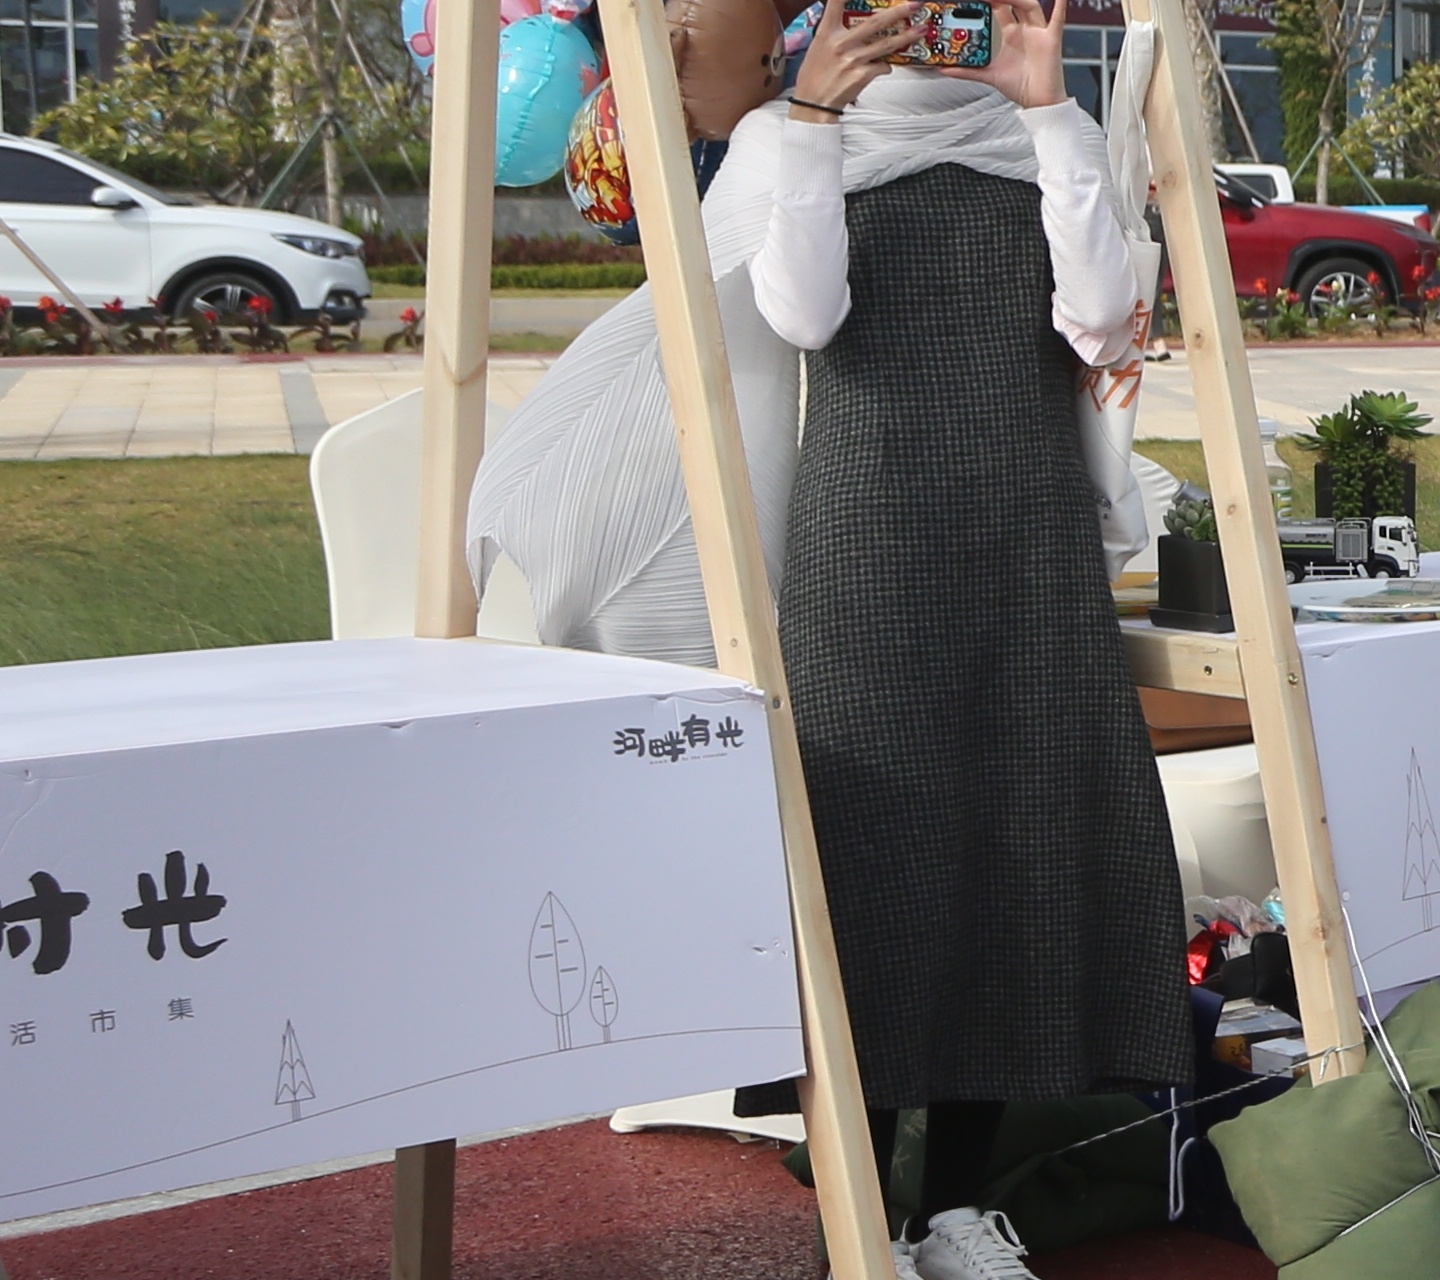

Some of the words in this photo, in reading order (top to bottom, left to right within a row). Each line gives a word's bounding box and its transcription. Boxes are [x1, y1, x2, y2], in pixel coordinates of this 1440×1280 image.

[612, 713, 744, 763] 河畔有光
[9, 997, 195, 1047] 活市集
